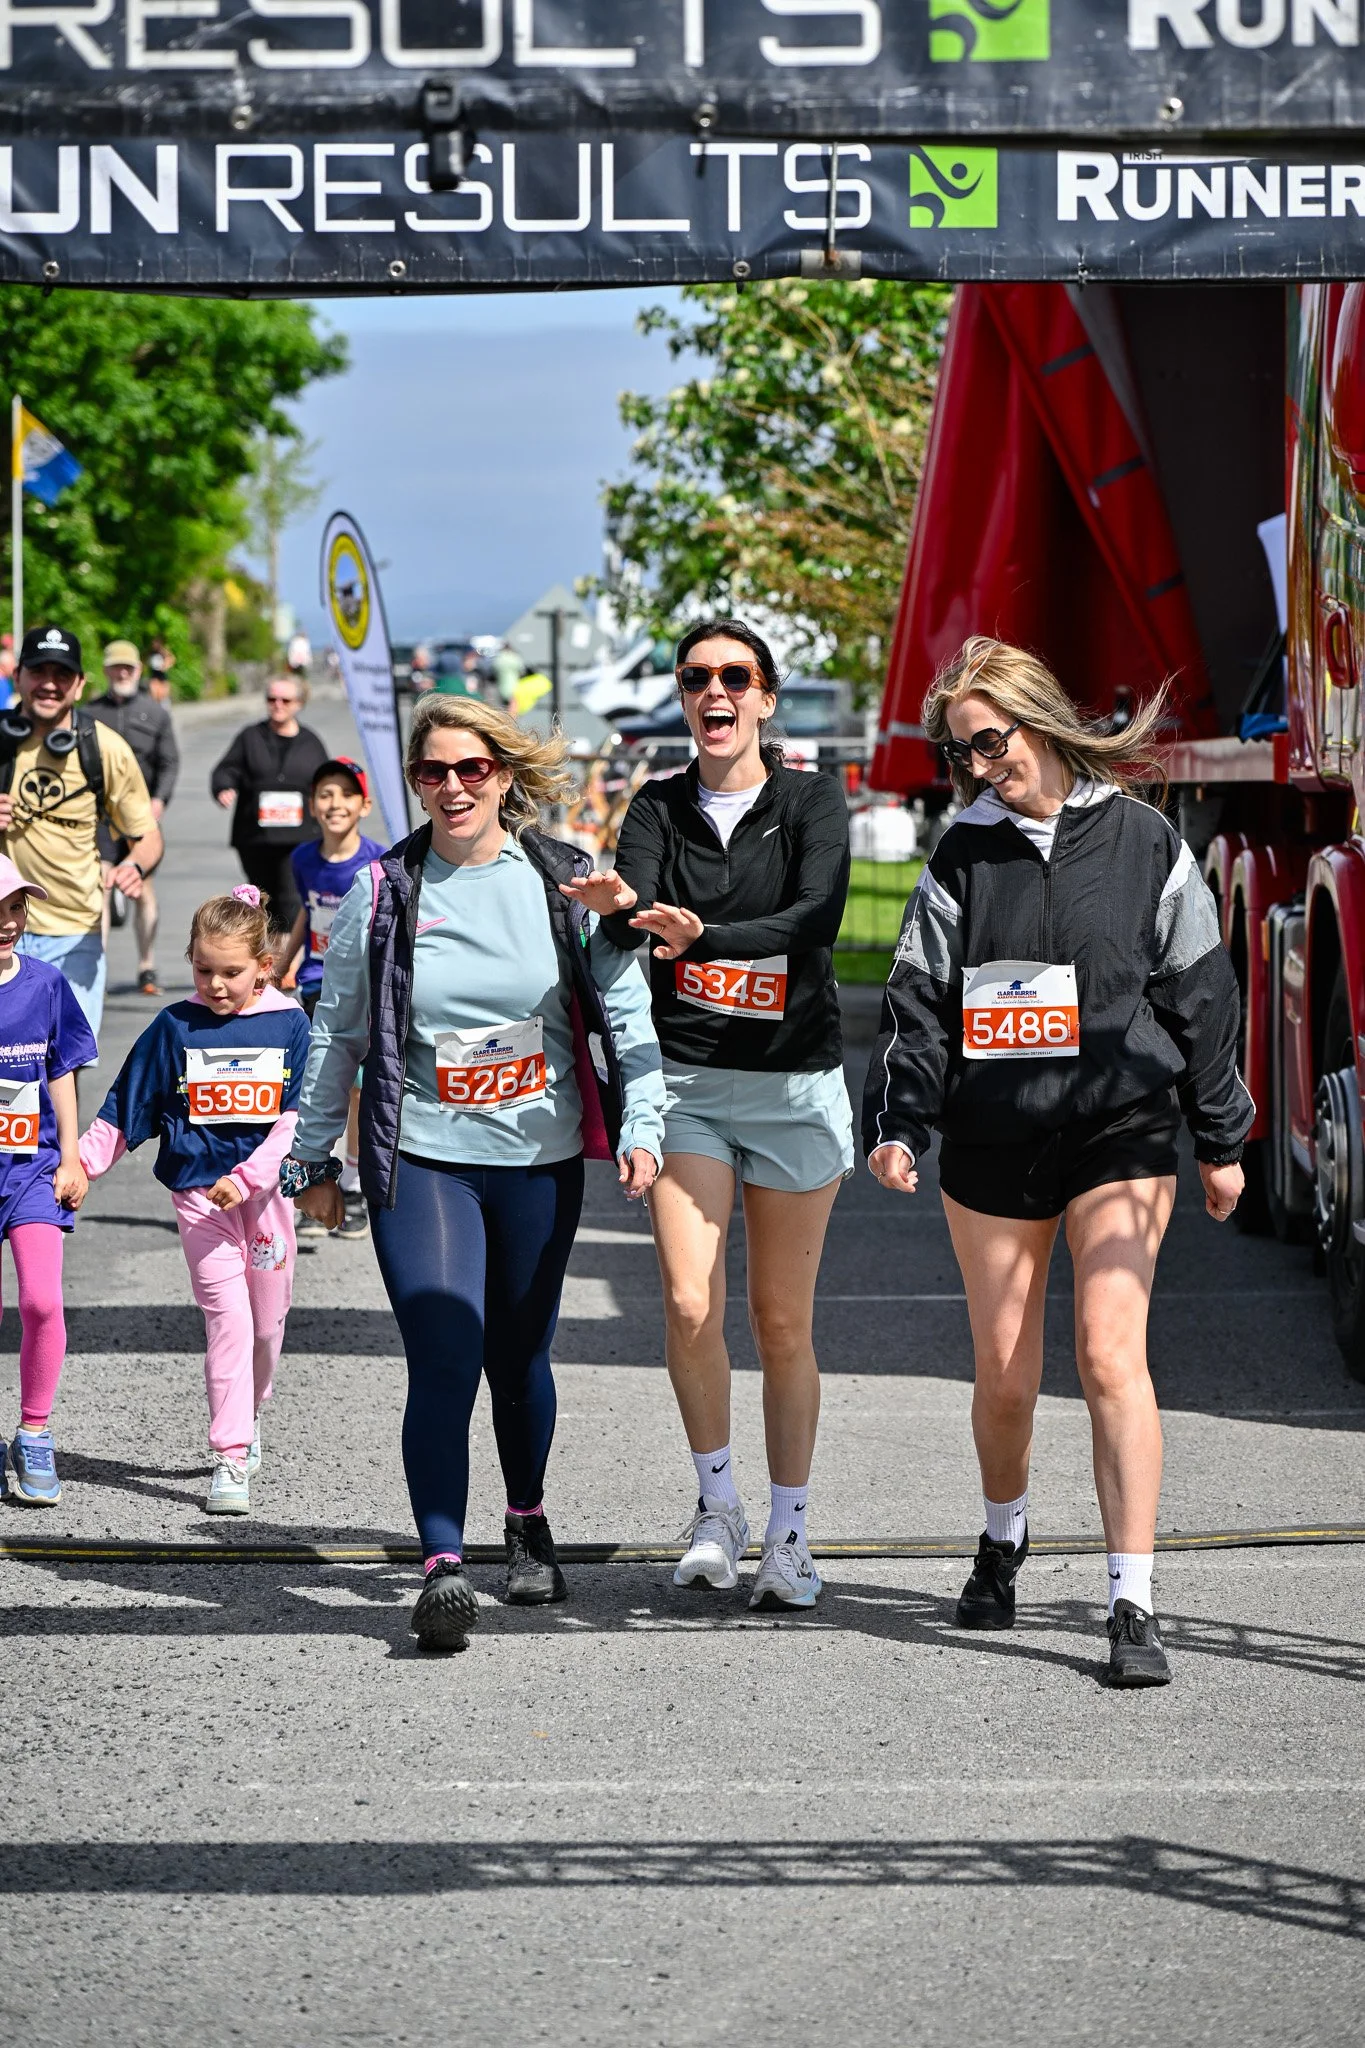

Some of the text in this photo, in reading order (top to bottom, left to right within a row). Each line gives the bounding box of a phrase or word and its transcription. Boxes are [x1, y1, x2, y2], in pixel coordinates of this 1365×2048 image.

[1130, 152, 1162, 161] IRISH
[0, 142, 871, 234] UN RESULTS
[1057, 151, 1365, 222] RUNNER
[683, 963, 776, 1007] 5345
[972, 1010, 1068, 1045] 5486
[473, 1046, 513, 1056] CLARE BURREN
[196, 1083, 274, 1113] 5390
[447, 1059, 540, 1101] 5264
